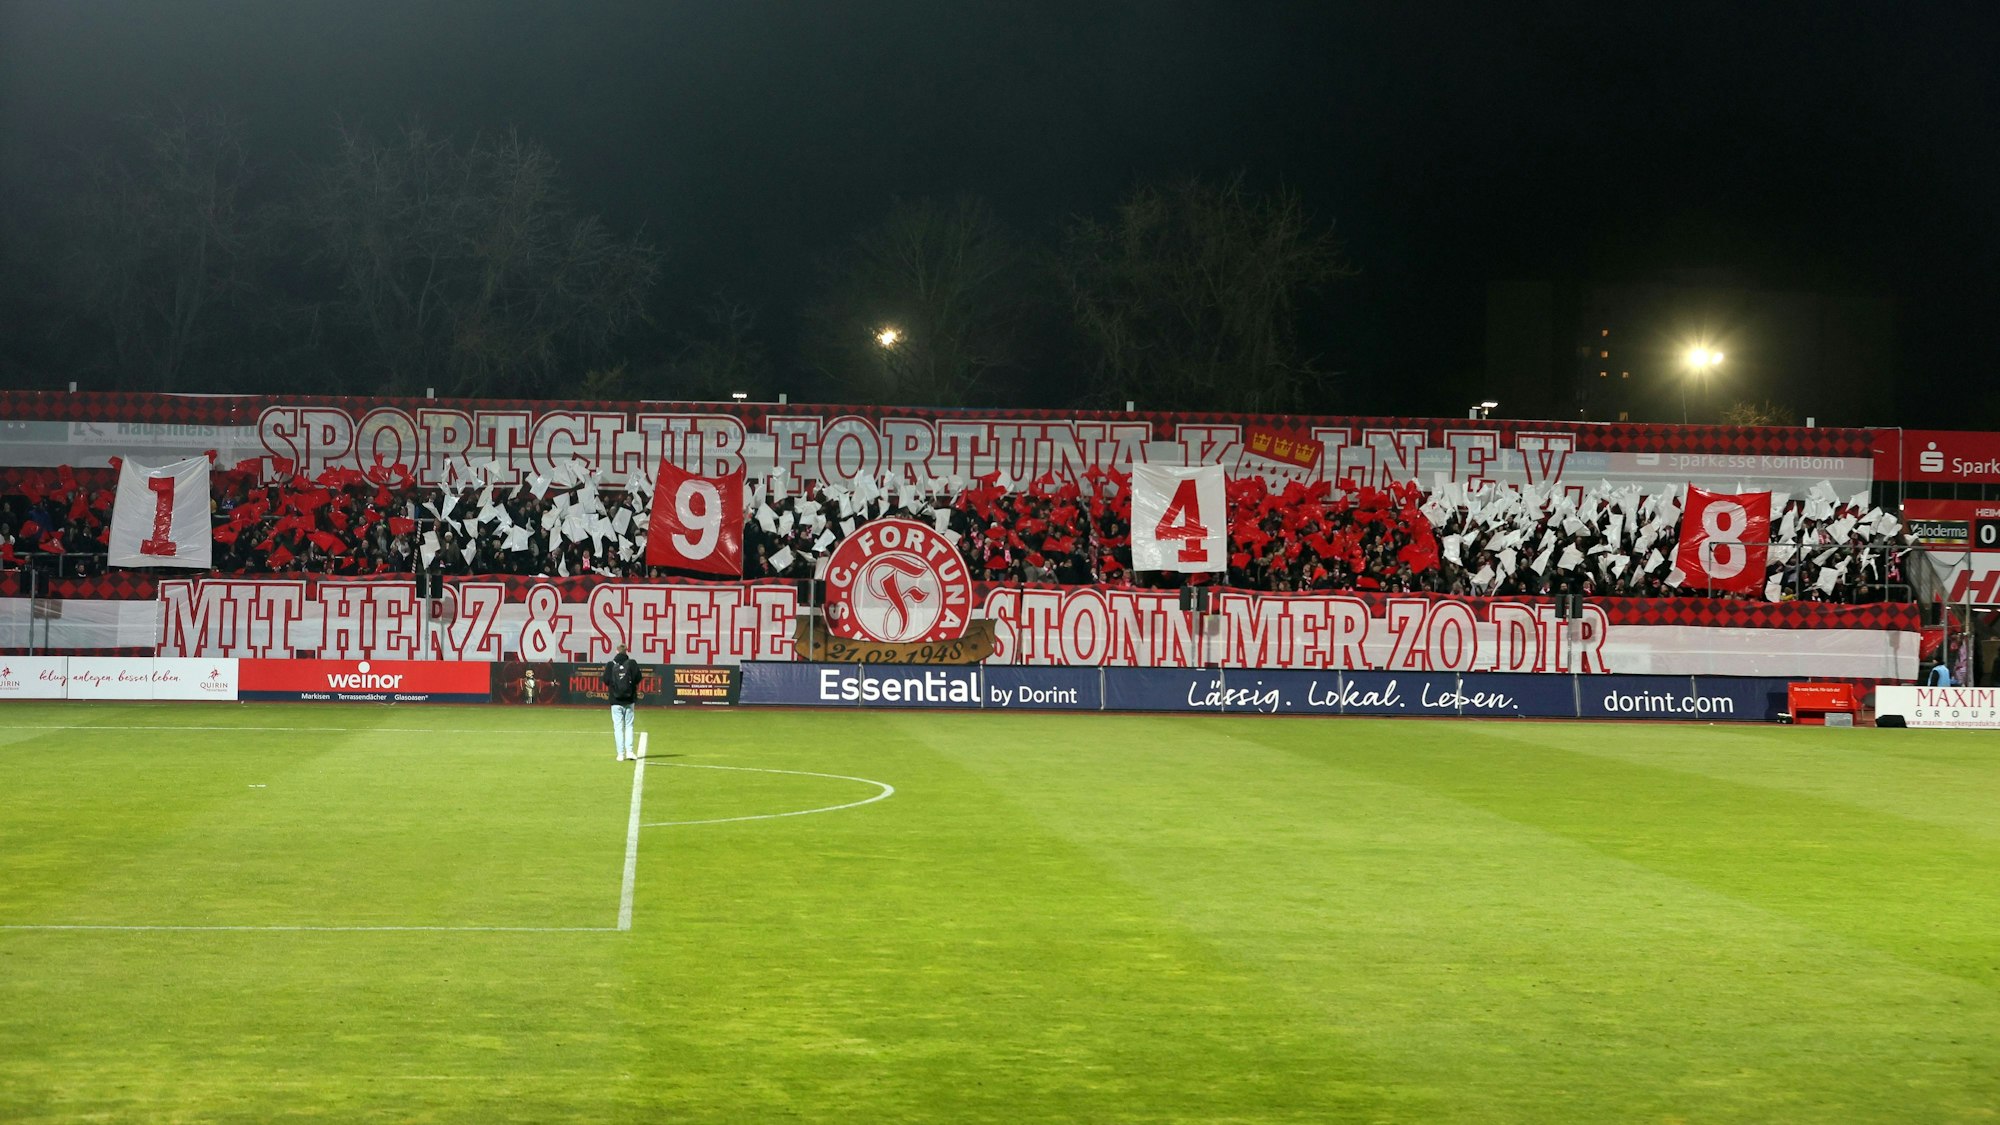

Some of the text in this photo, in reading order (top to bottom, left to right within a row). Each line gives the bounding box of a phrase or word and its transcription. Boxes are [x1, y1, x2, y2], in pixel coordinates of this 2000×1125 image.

[257, 406, 748, 490] SPORTCLUB
[766, 415, 1153, 497] FORTUNA
[140, 477, 177, 556] 1
[671, 479, 723, 561] 9
[1155, 479, 1209, 563] 4
[1698, 500, 1748, 580] 8
[1980, 525, 1997, 544] 0
[857, 525, 966, 629] FORTUNA
[158, 580, 1613, 674] MIT HERZ & SEELE STONN MER ZO DIR
[827, 642, 964, 664] 21.02.1948
[73, 670, 113, 687] anlegen.
[118, 670, 148, 682] besser
[152, 670, 181, 682] leben.
[200, 682, 228, 690] QUIRIN
[327, 661, 403, 689] weinor
[674, 673, 730, 684] MUSICAL
[819, 669, 1078, 706] Essential by Dorint
[1187, 680, 1519, 713] Lässig. Lokal. Leben.
[1603, 690, 1734, 713] dorint.com
[1916, 688, 1995, 708] MAXIM
[1915, 709, 1996, 718] GROUP
